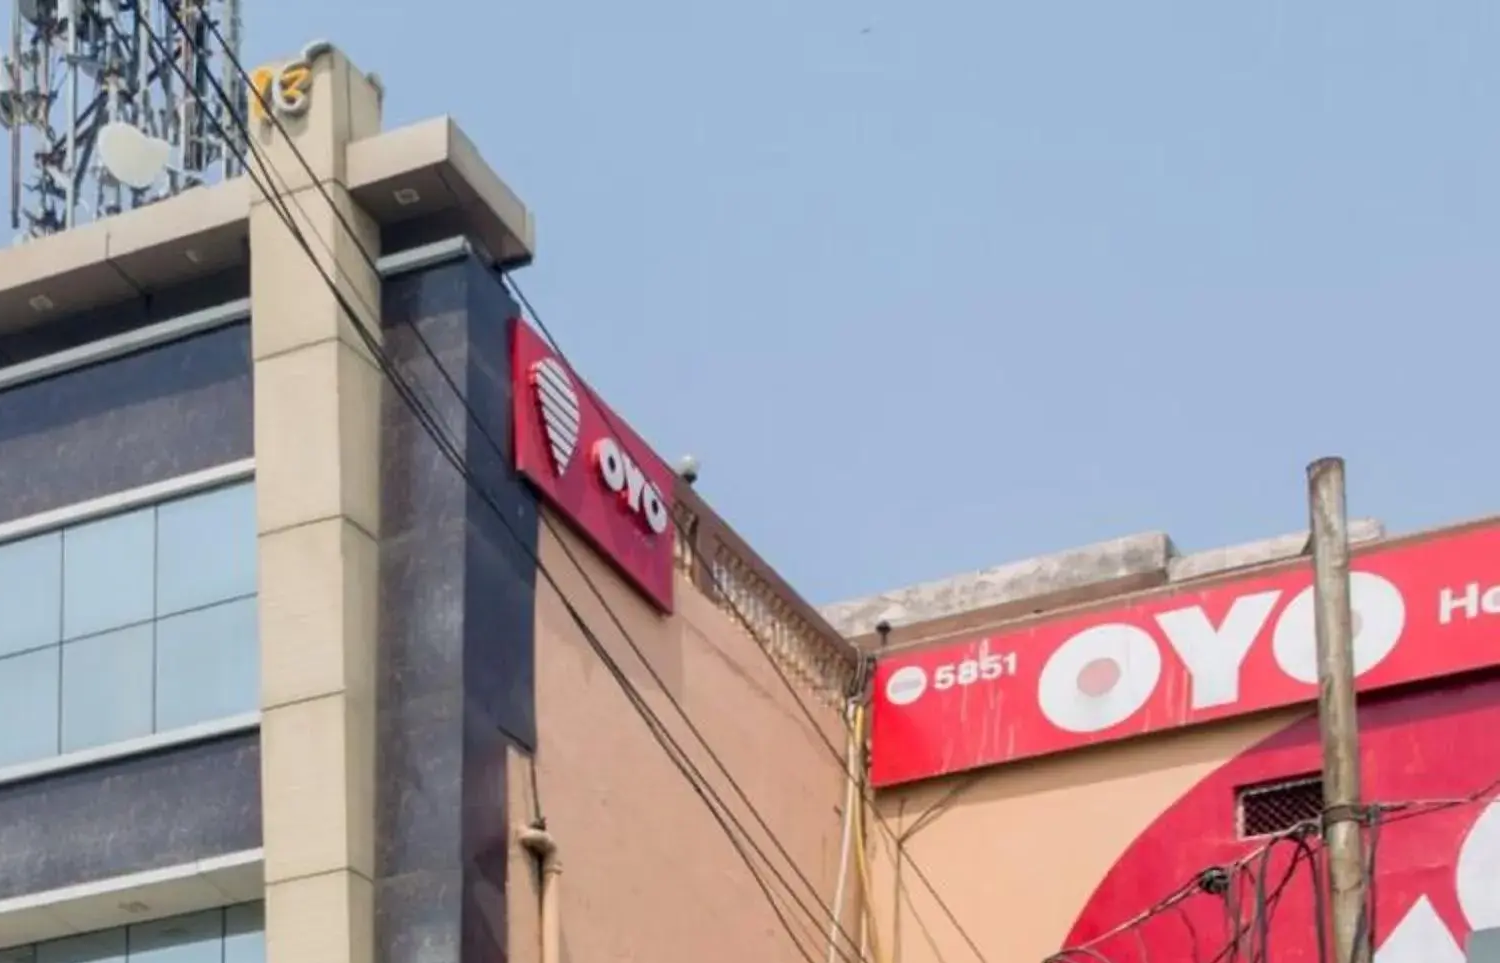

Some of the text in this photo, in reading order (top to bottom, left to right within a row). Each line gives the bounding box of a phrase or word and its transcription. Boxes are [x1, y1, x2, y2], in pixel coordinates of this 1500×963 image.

[592, 438, 668, 534] OYO
[934, 652, 1017, 690] 5851
[1038, 571, 1405, 733] OYO
